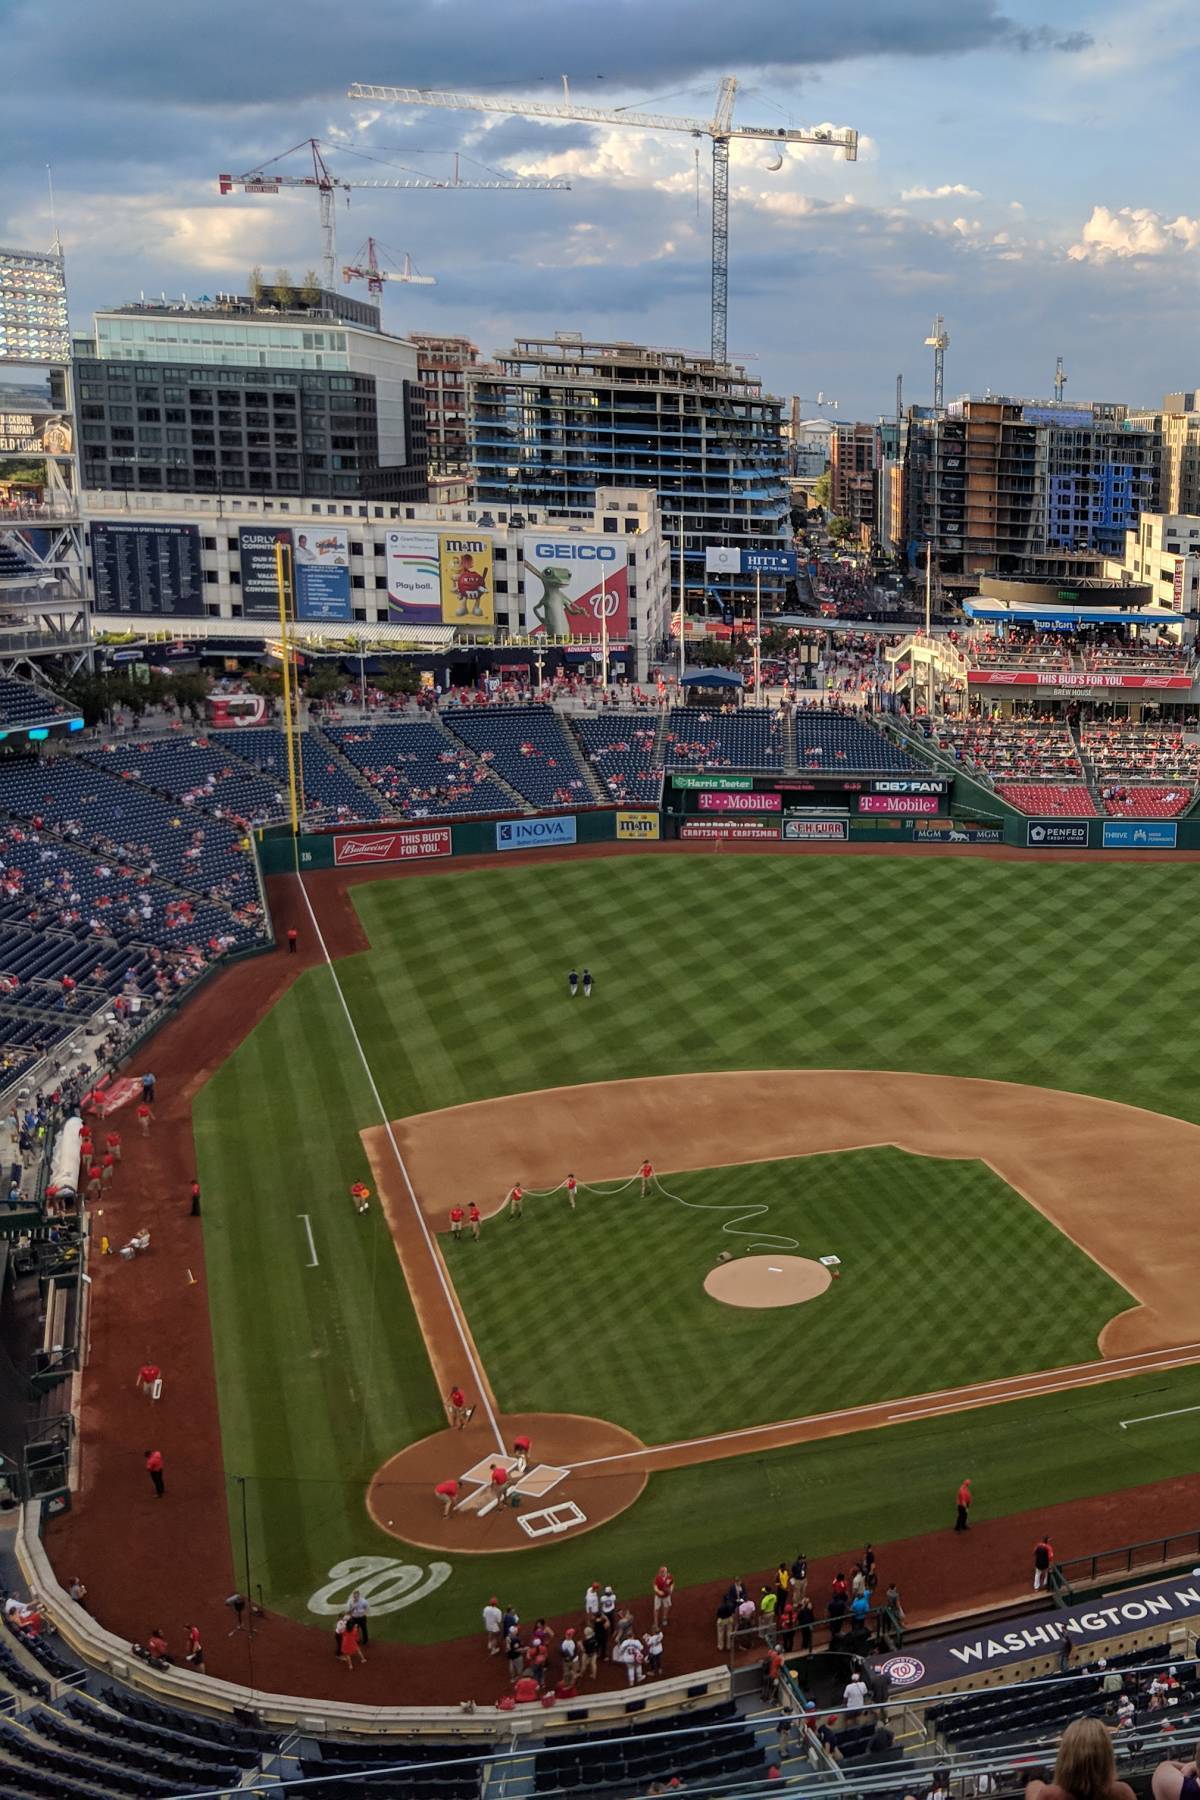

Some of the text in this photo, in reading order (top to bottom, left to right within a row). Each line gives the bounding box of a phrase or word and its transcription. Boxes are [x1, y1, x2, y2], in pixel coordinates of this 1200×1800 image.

[17, 438, 43, 451] LODGE
[241, 534, 276, 543] CURLY
[535, 543, 616, 561] GEICO
[747, 556, 779, 566] HITT
[396, 581, 414, 591] Play
[1037, 674, 1124, 686] THIS BUD'S FOR YOU.
[1072, 689, 1092, 697] HOUSE
[687, 777, 750, 788] Harris Teeter
[910, 782, 943, 792] FAN
[516, 822, 564, 837] INOVA
[918, 830, 999, 839] MGM MGM
[1047, 828, 1084, 837] PENFED
[400, 831, 449, 845] THIS BUD'S
[342, 843, 390, 854] Budweiser
[401, 843, 441, 855] FOR YOU.
[949, 1595, 1174, 1664] WASHINGTON
